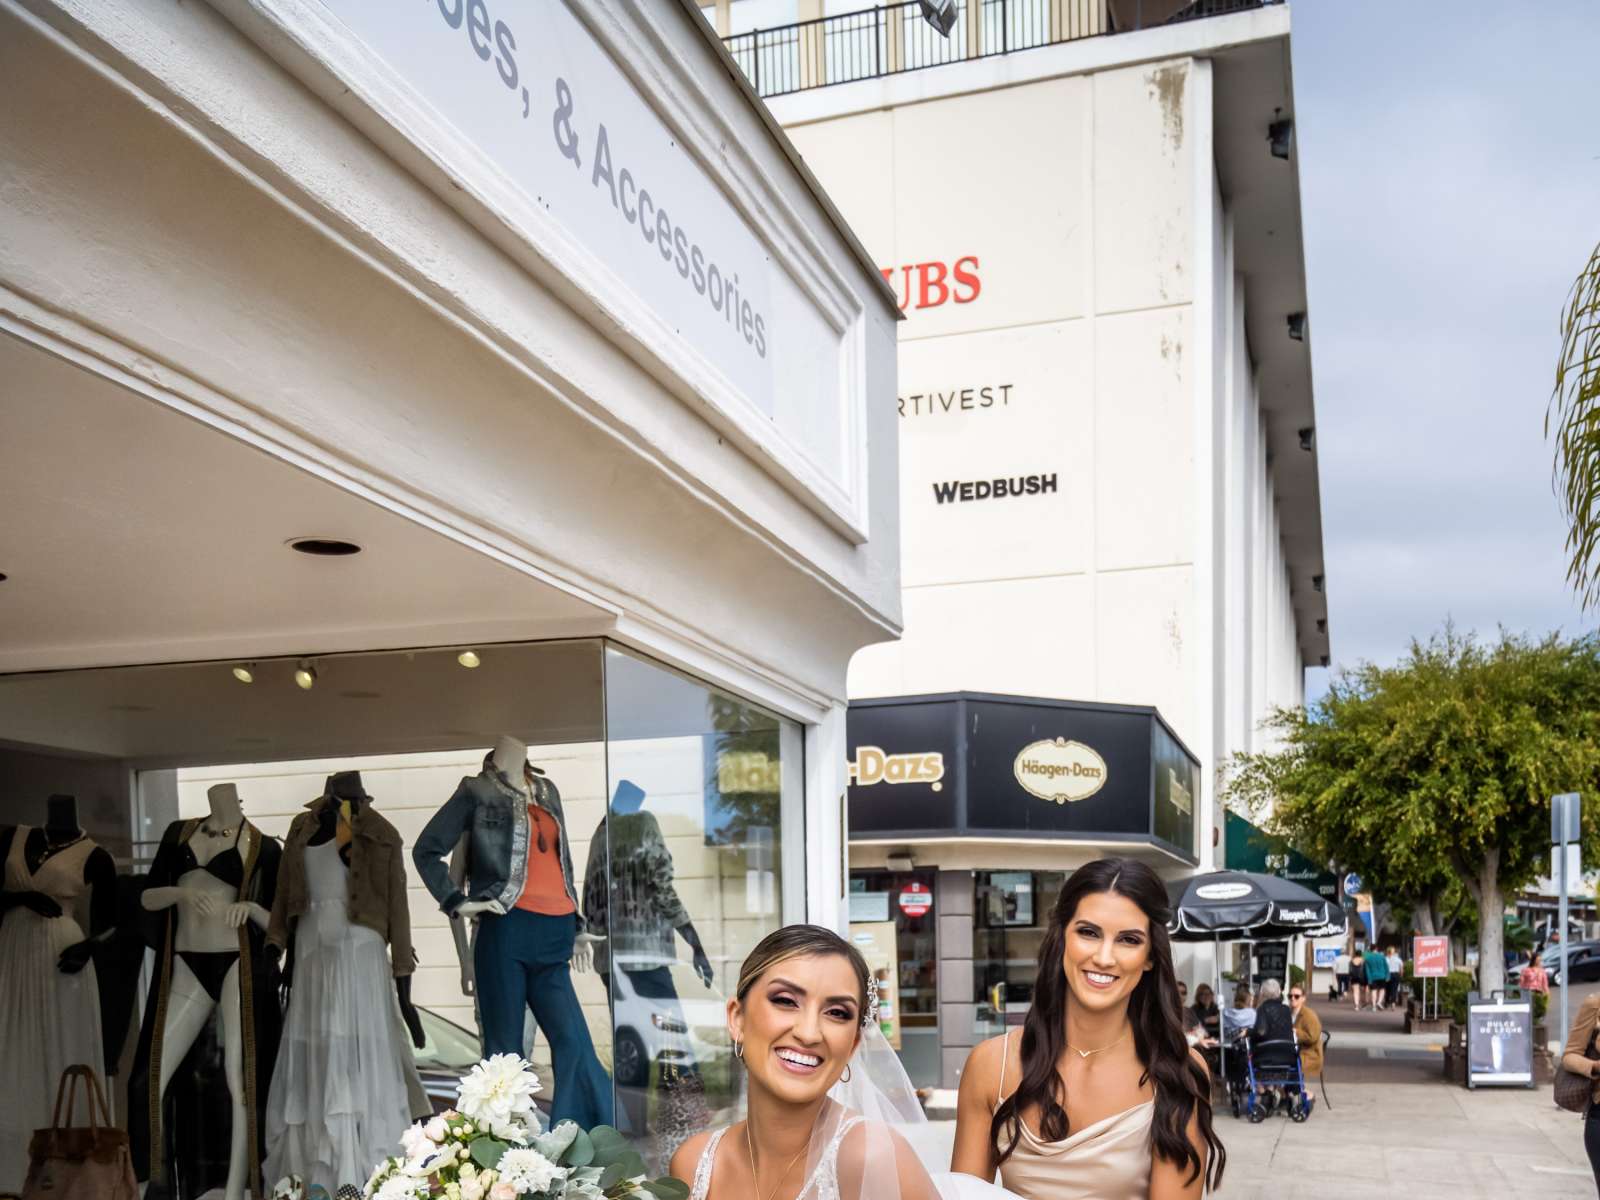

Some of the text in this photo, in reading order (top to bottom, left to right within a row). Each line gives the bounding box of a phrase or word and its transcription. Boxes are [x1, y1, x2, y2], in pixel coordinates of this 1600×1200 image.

[553, 77, 582, 169] &
[592, 123, 767, 359] Accessories
[933, 473, 1058, 504] WEDBUSH
[1022, 759, 1101, 779] Häagen-Dazs
